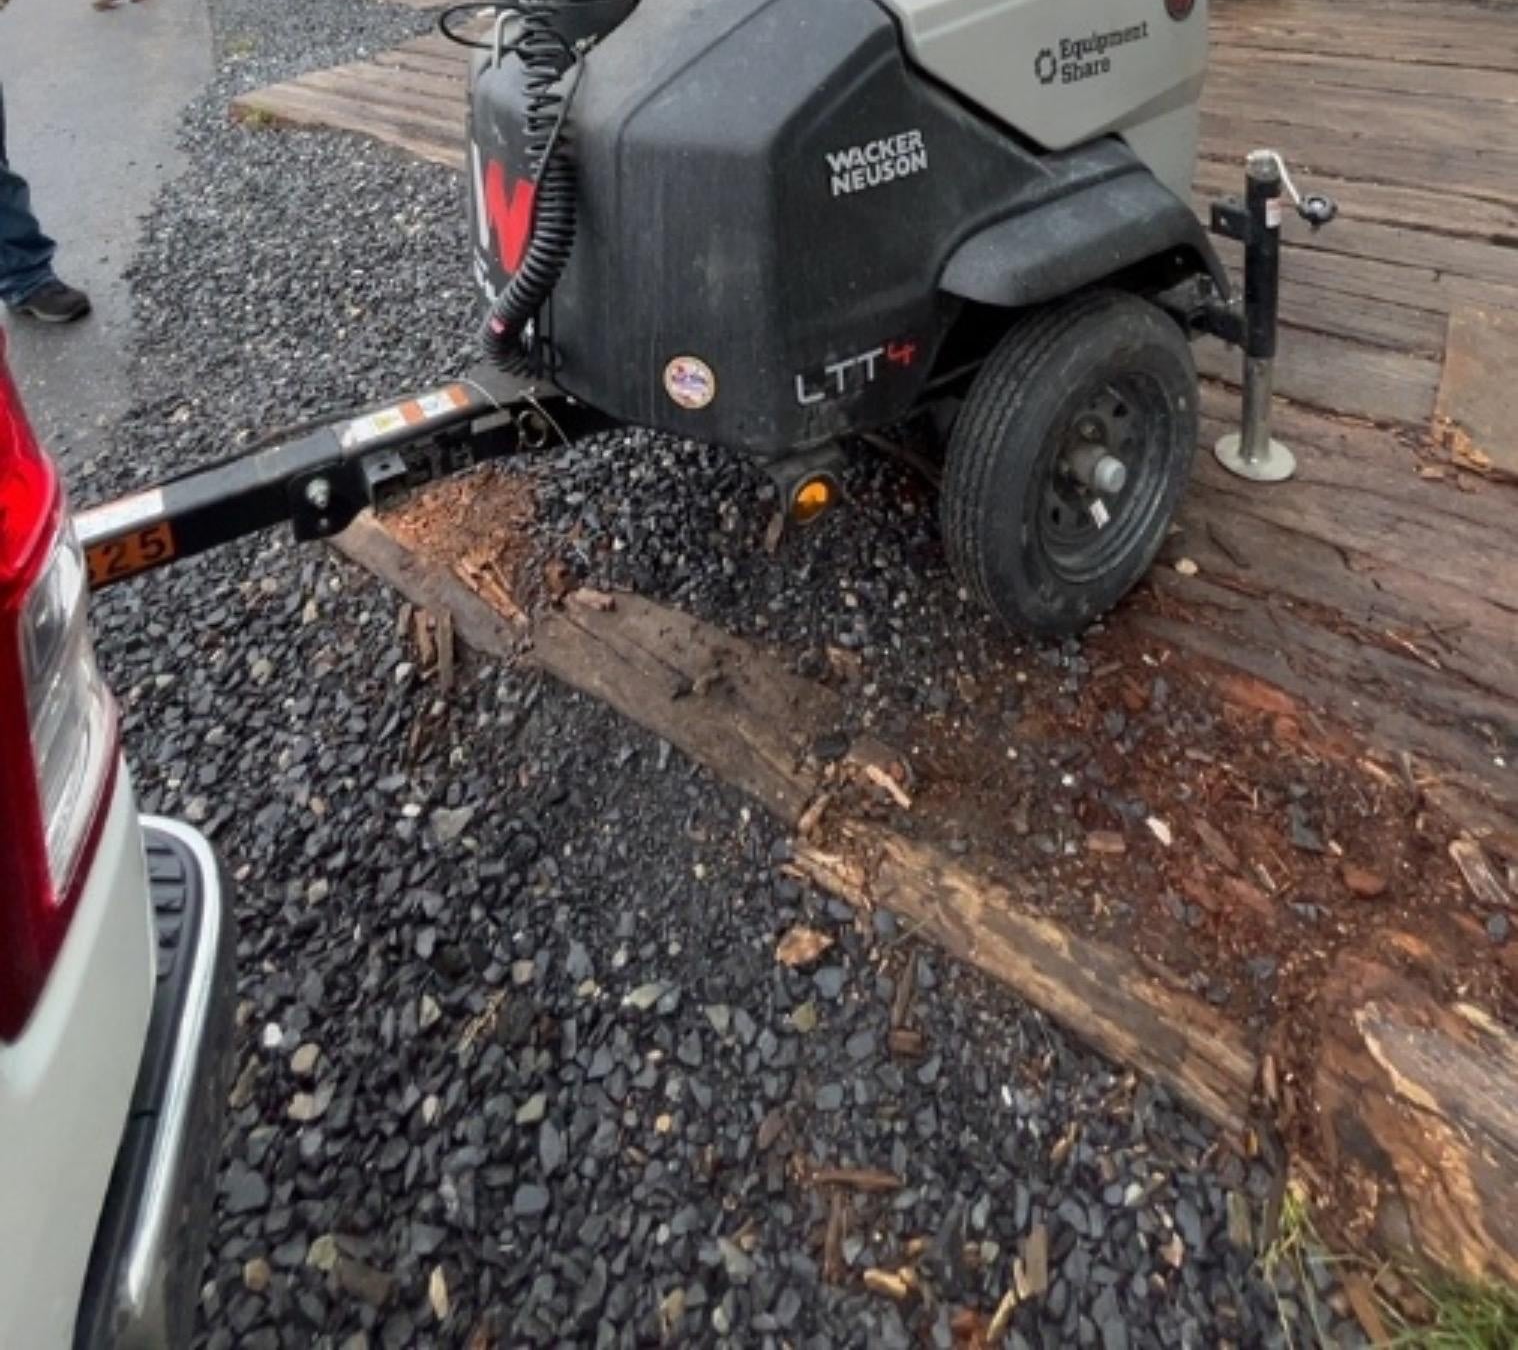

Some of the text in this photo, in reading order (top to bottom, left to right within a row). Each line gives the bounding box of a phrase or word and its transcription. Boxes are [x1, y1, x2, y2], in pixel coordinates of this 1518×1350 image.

[1059, 20, 1149, 61] Equipment
[1060, 57, 1112, 85] Share
[825, 128, 925, 173] WACKER
[831, 149, 928, 197] NEUSON
